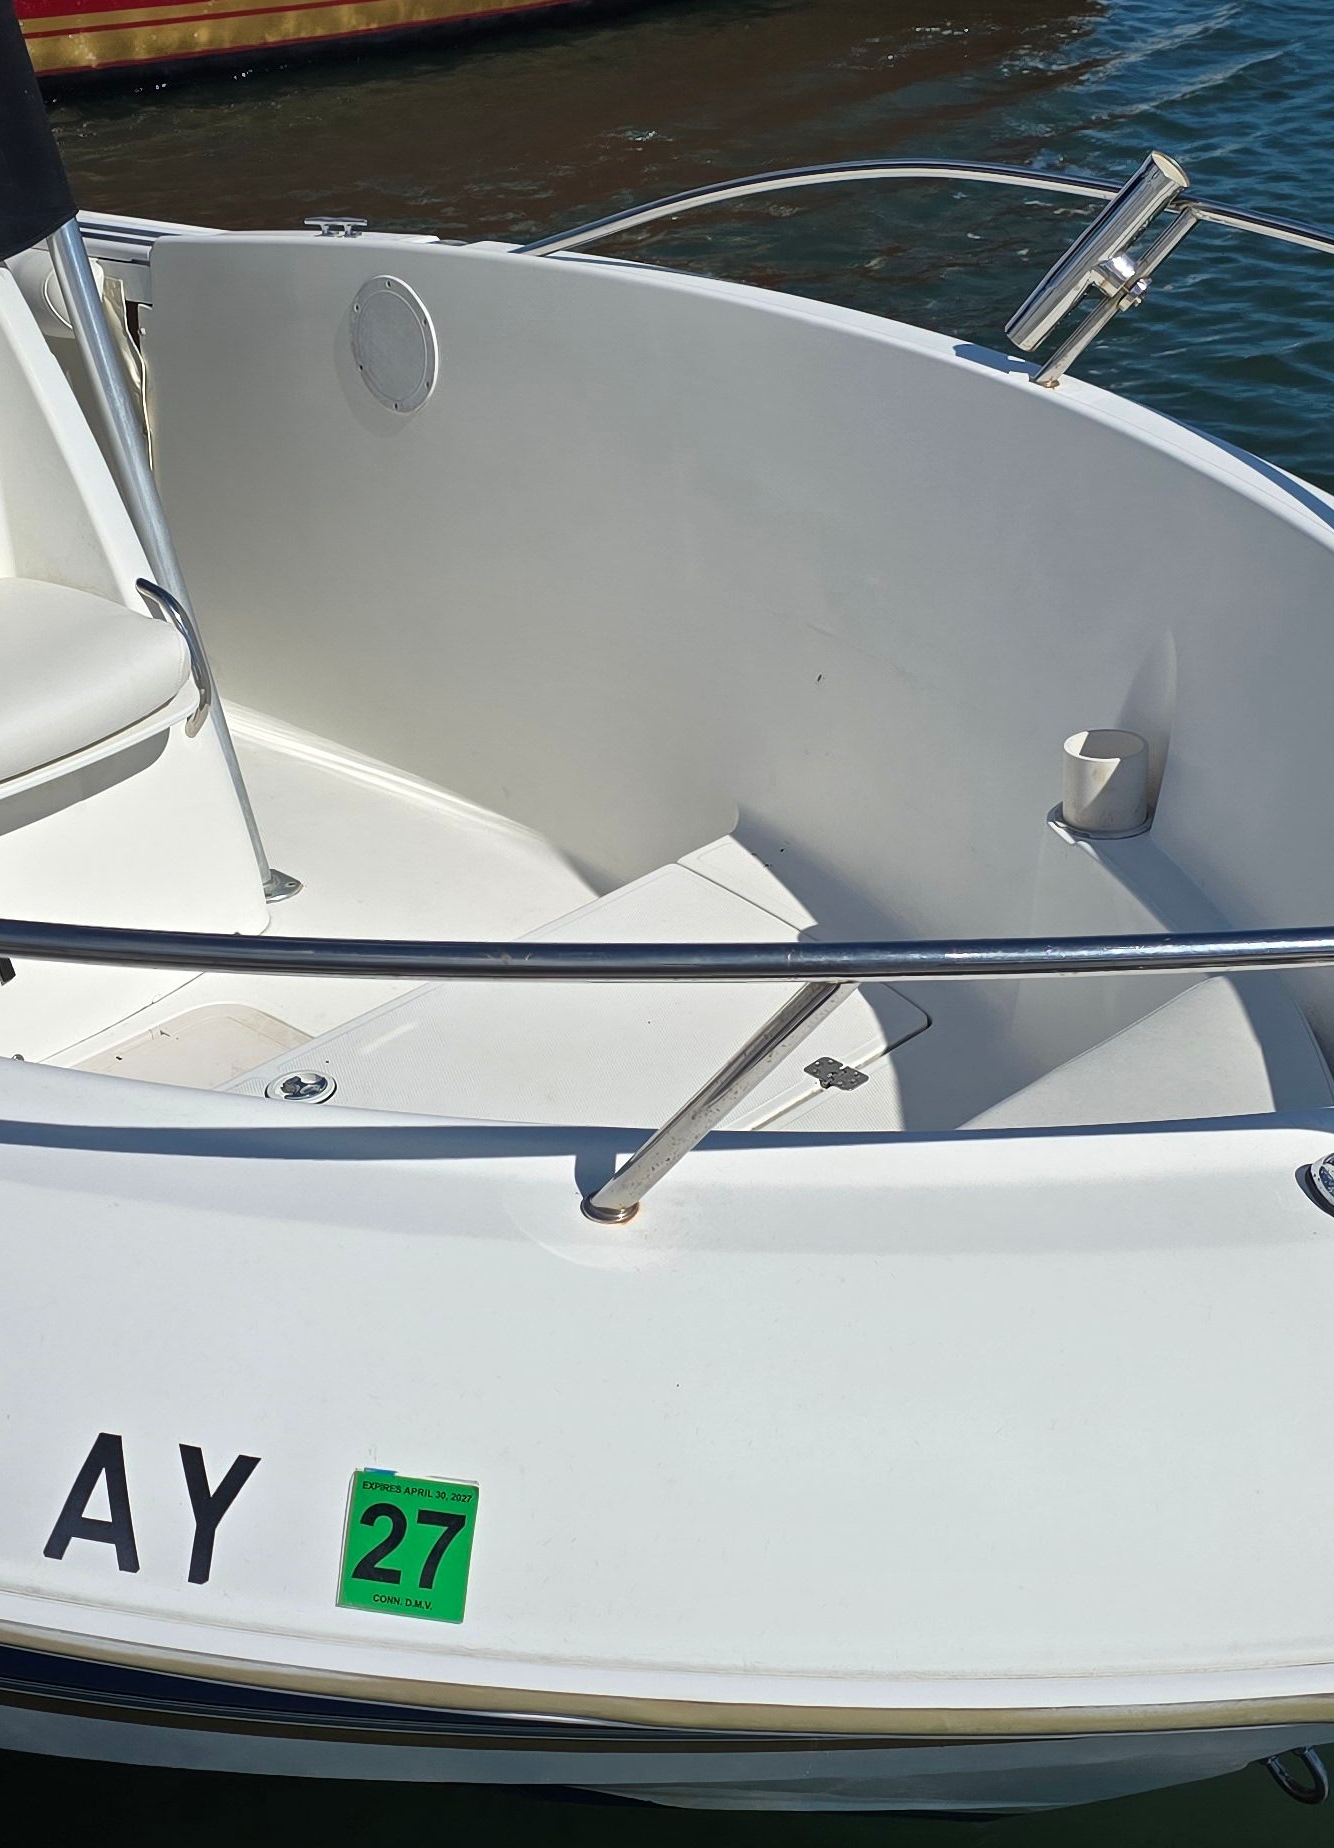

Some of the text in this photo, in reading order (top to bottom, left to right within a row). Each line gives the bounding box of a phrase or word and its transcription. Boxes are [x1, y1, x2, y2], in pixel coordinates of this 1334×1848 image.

[43, 1432, 262, 1584] AY
[362, 1481, 473, 1503] EXPIRES APRIL 30, 2027
[351, 1502, 467, 1590] 27
[373, 1594, 403, 1606] CONN.
